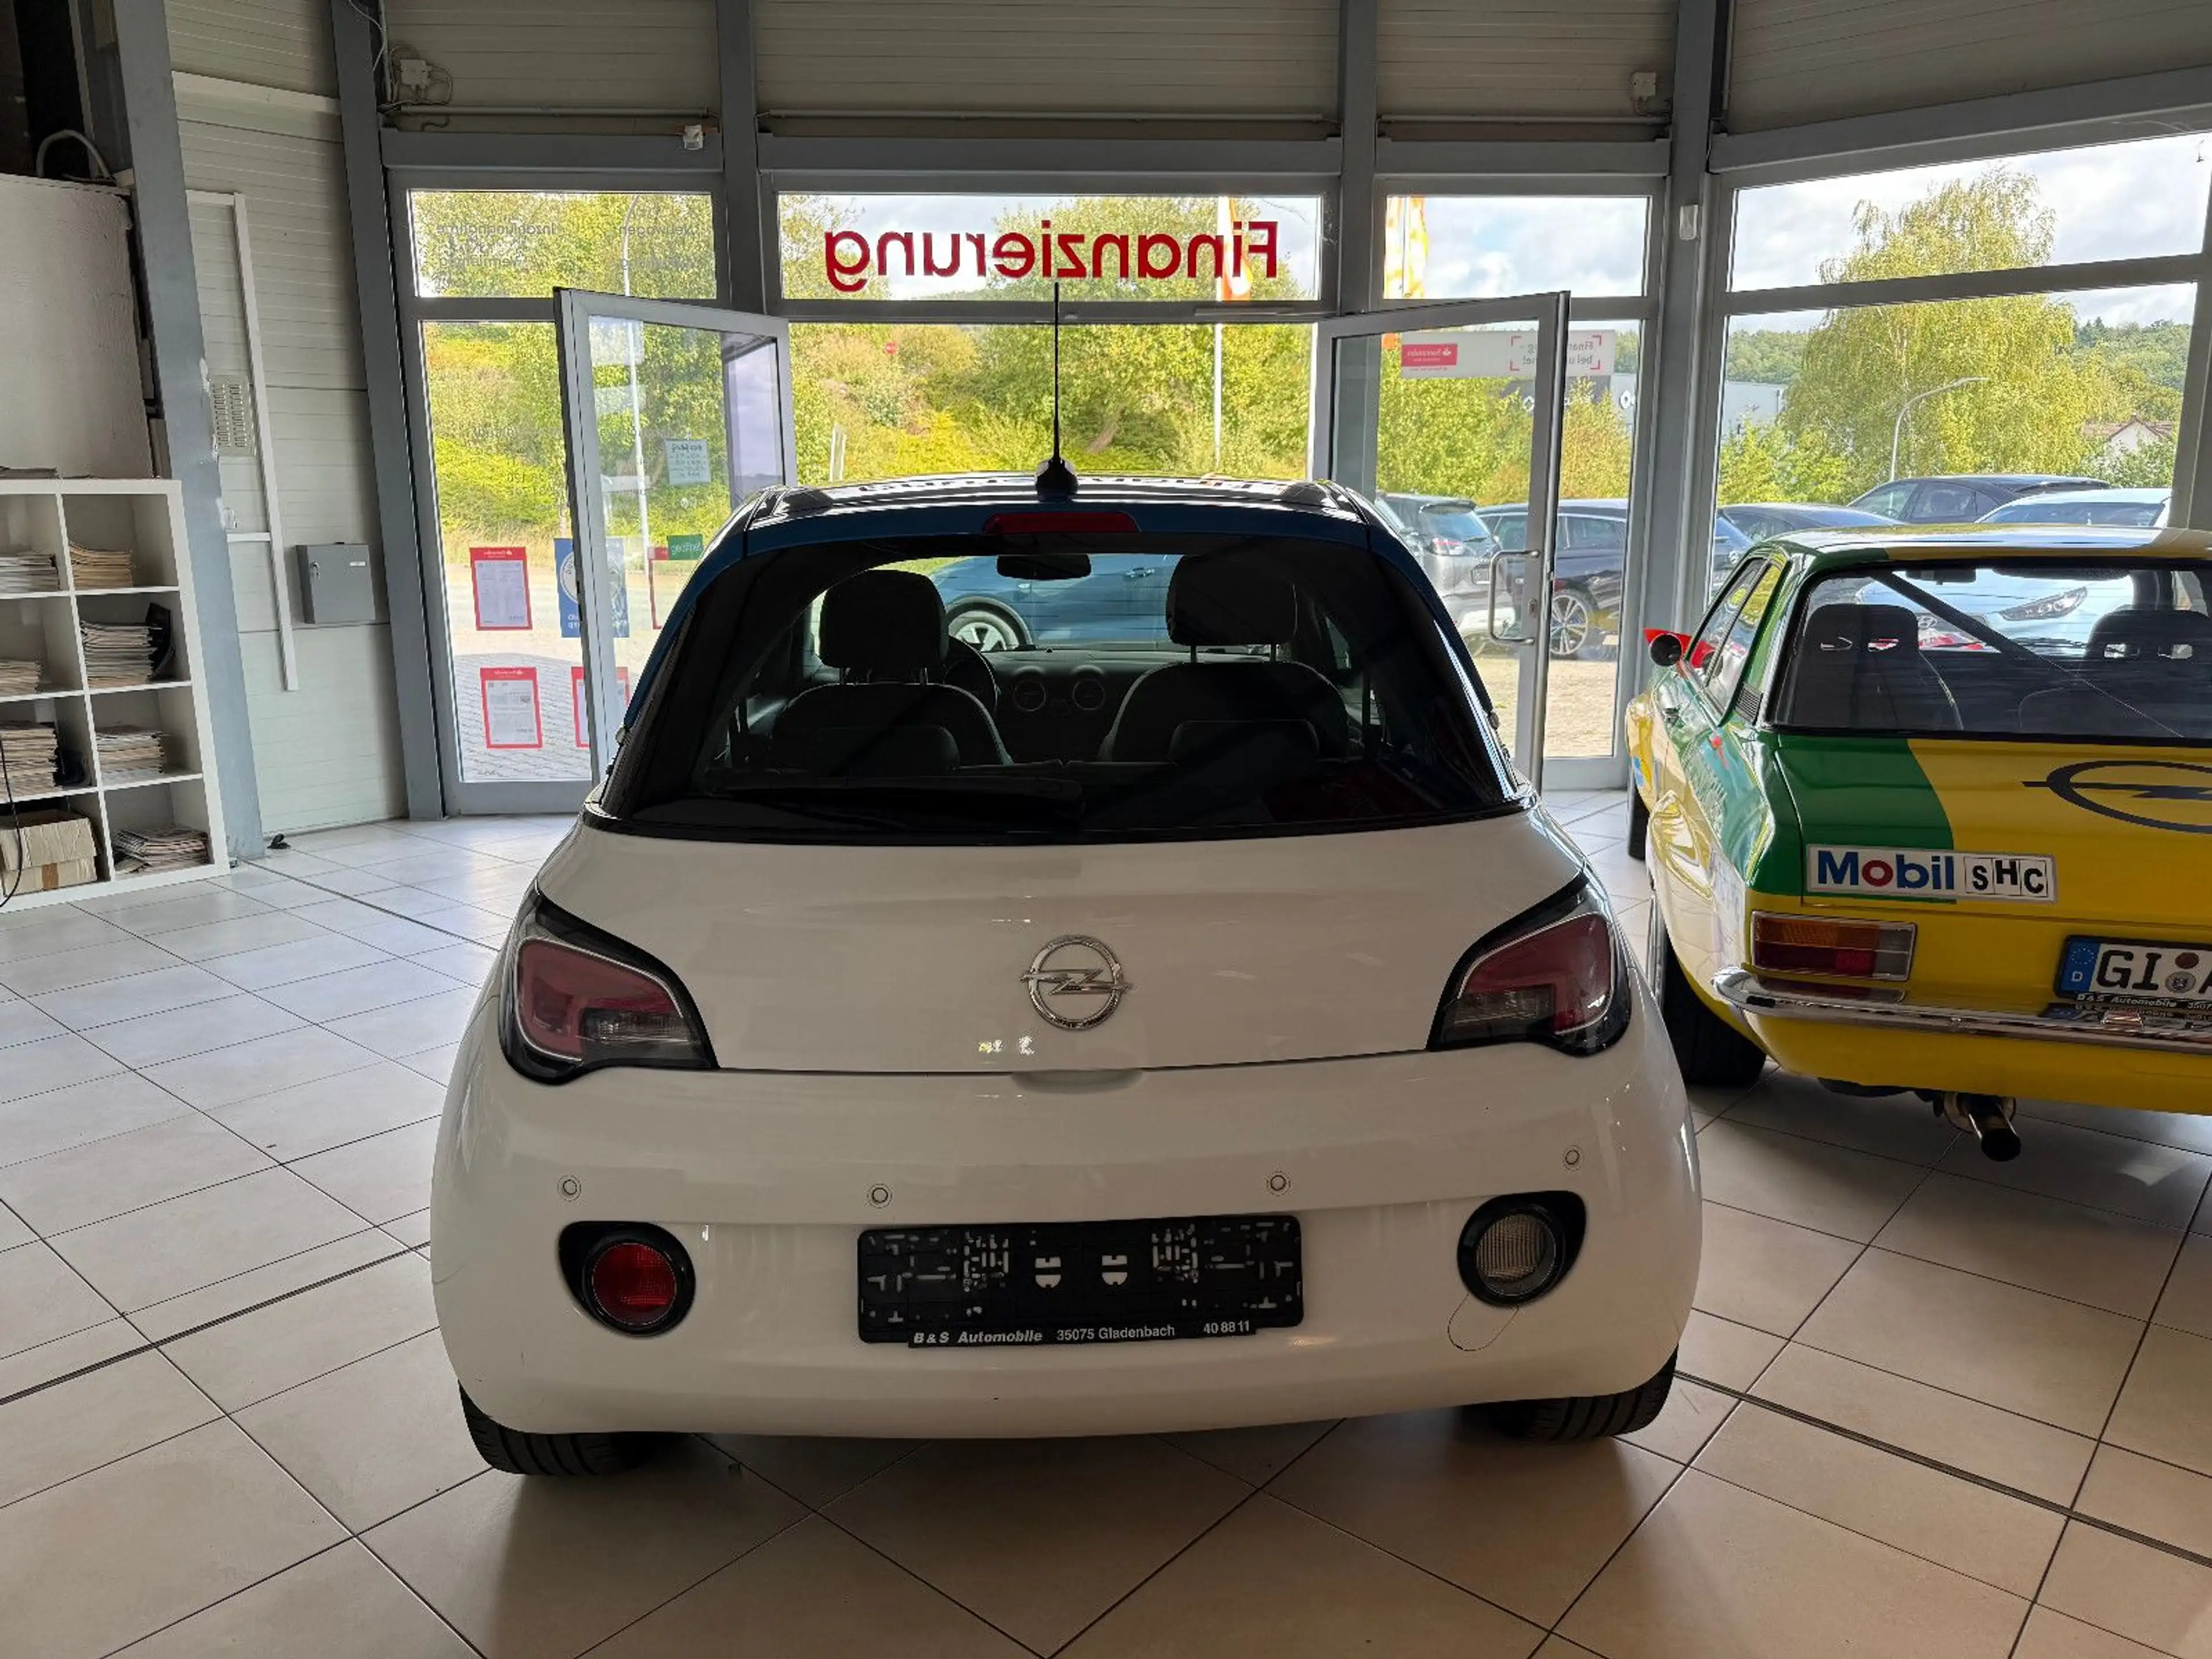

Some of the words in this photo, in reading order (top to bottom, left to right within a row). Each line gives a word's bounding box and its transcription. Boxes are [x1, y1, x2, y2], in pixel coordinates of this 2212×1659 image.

[1817, 850, 1955, 889] Mobil
[1971, 859, 2044, 894] SHC
[2096, 950, 2162, 990] GI
[2110, 997, 2177, 1008] Automobile
[914, 1332, 925, 1344] B
[926, 1333, 937, 1343] &
[939, 1332, 950, 1343] S
[957, 1330, 1043, 1343] Automobile
[1056, 1328, 1094, 1340] 35075
[1099, 1324, 1175, 1339] Gladenbach
